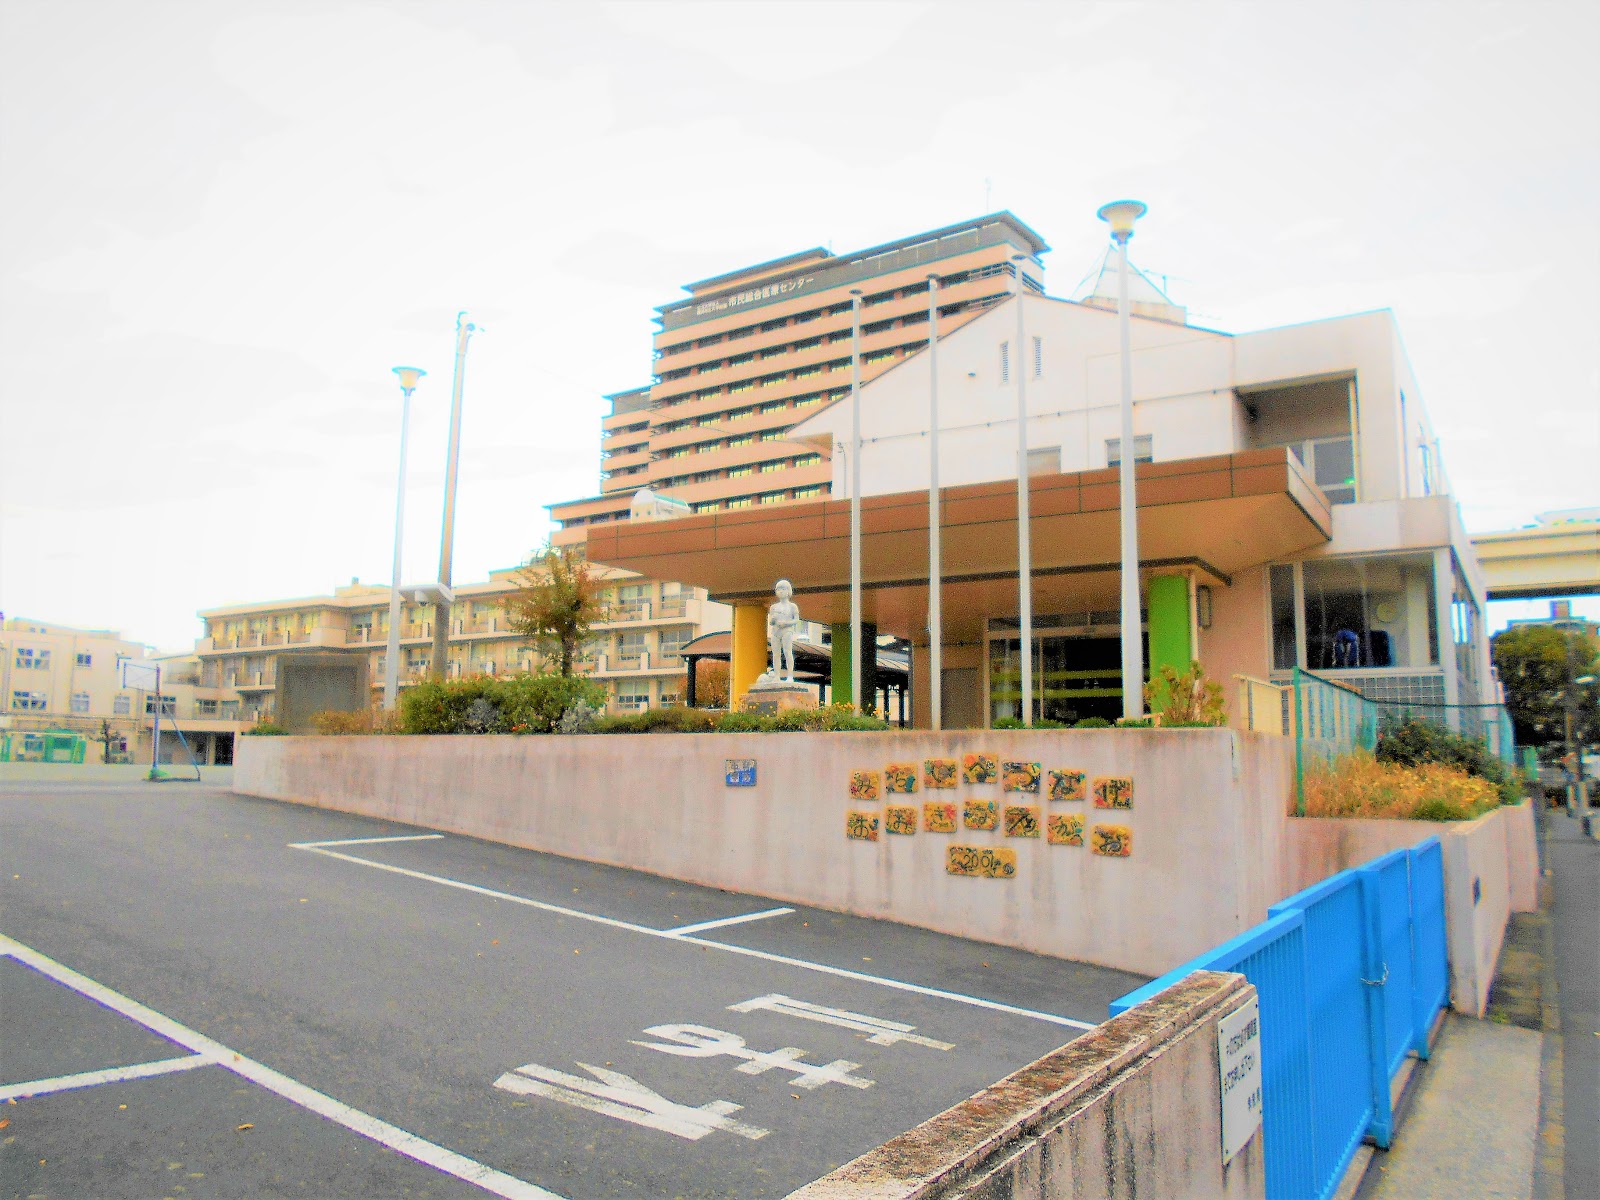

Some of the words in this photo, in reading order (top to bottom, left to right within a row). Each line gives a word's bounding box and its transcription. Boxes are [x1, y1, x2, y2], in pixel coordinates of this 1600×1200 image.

[728, 278, 814, 307] 市民総合医療センター
